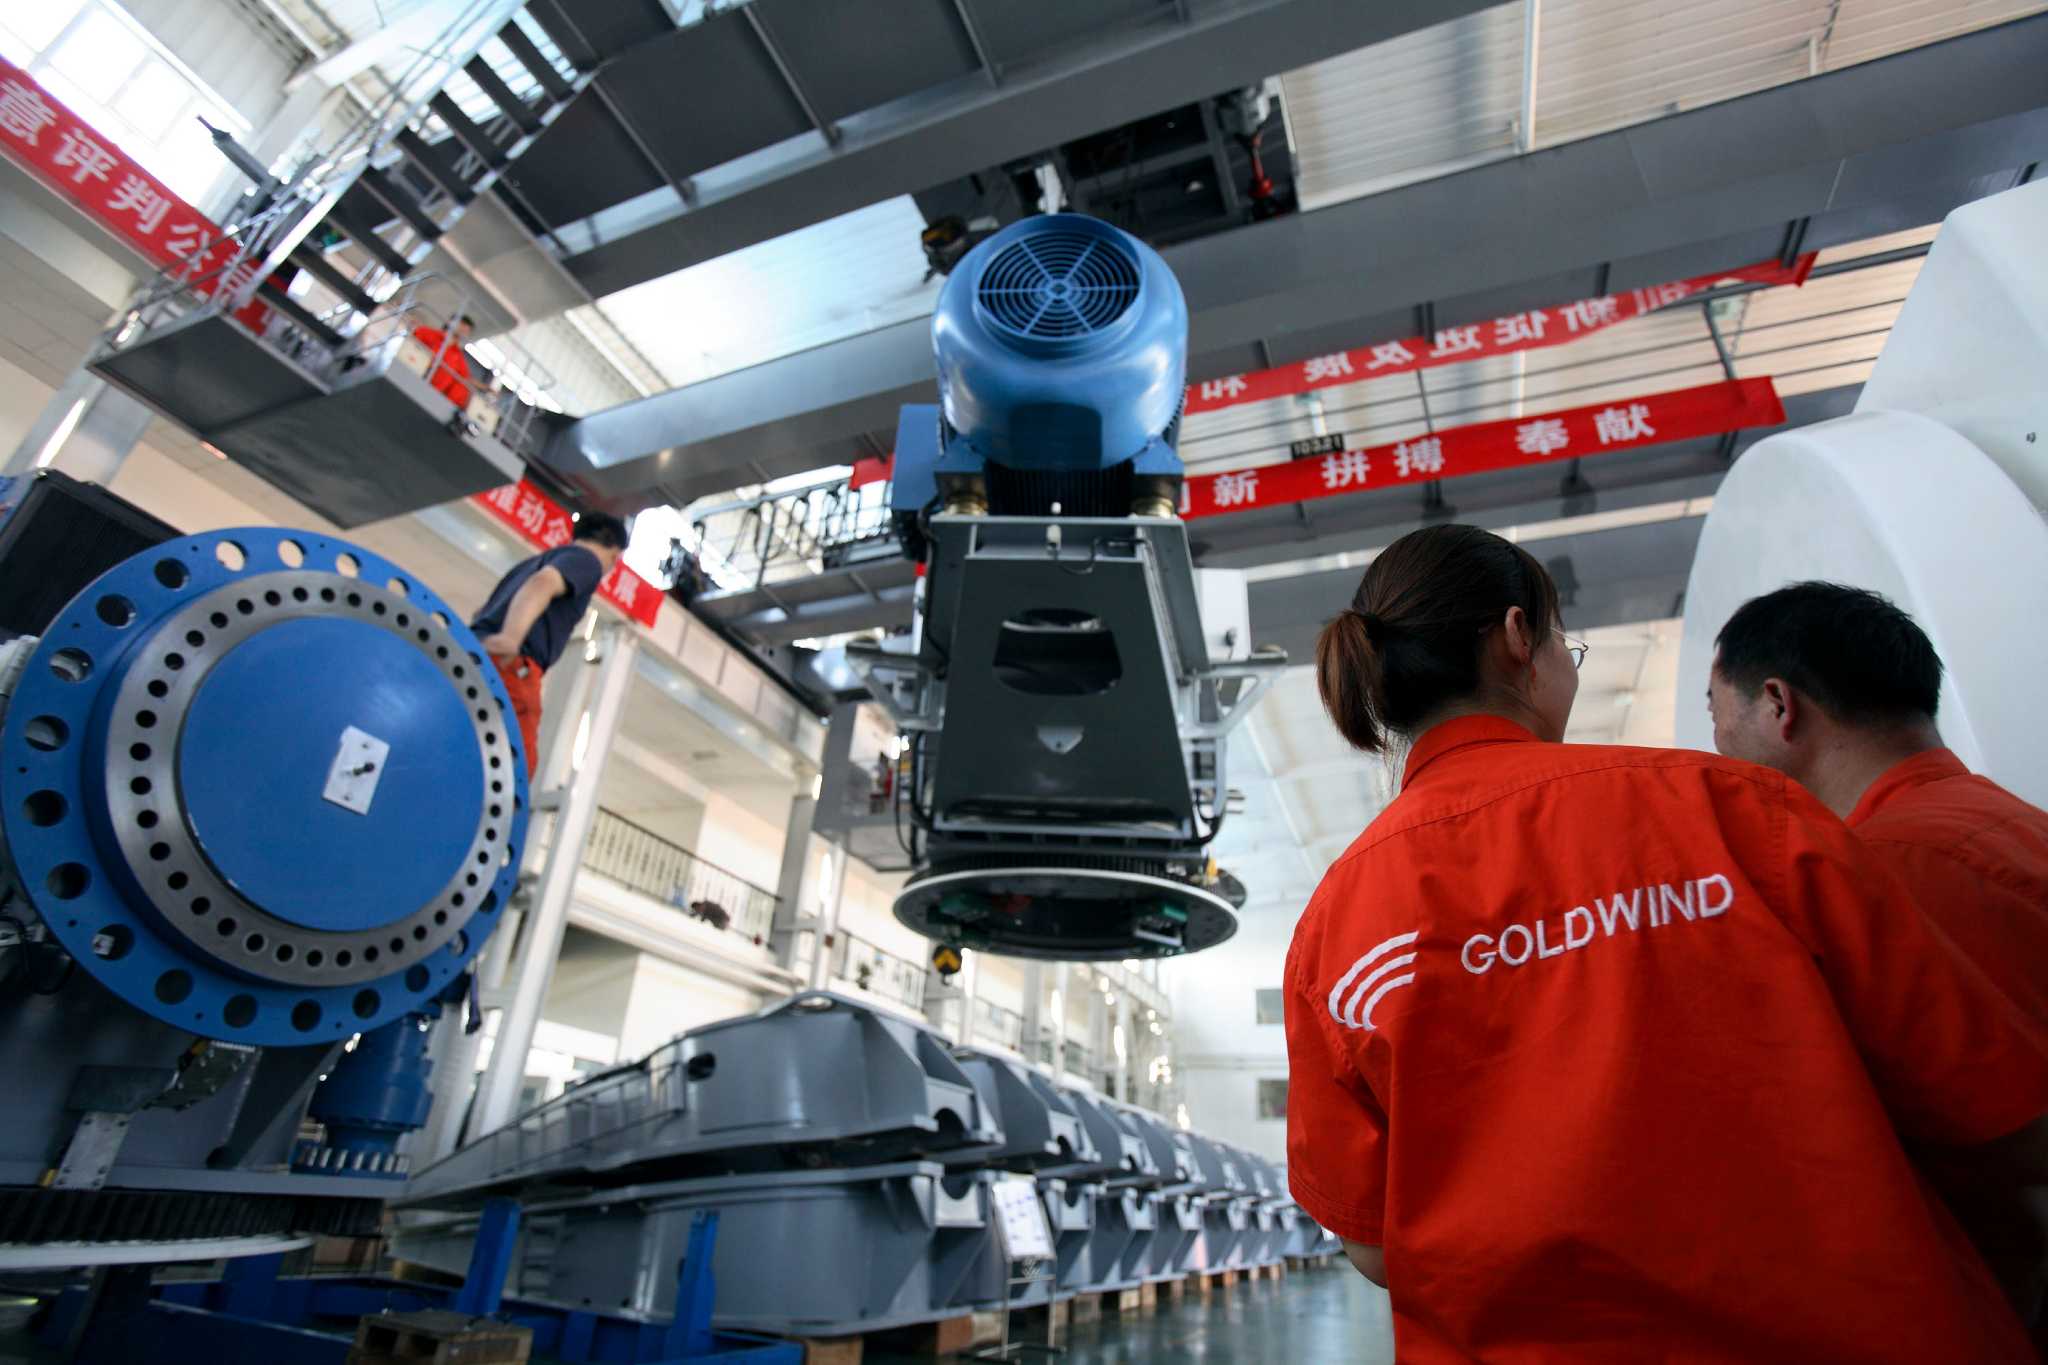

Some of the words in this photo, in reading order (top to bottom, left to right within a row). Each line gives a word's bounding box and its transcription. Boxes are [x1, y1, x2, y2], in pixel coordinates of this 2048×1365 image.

[1321, 437, 1446, 489] 拼搏
[1515, 403, 1657, 455] 奉献
[1460, 873, 1734, 975] GOLDWIND
